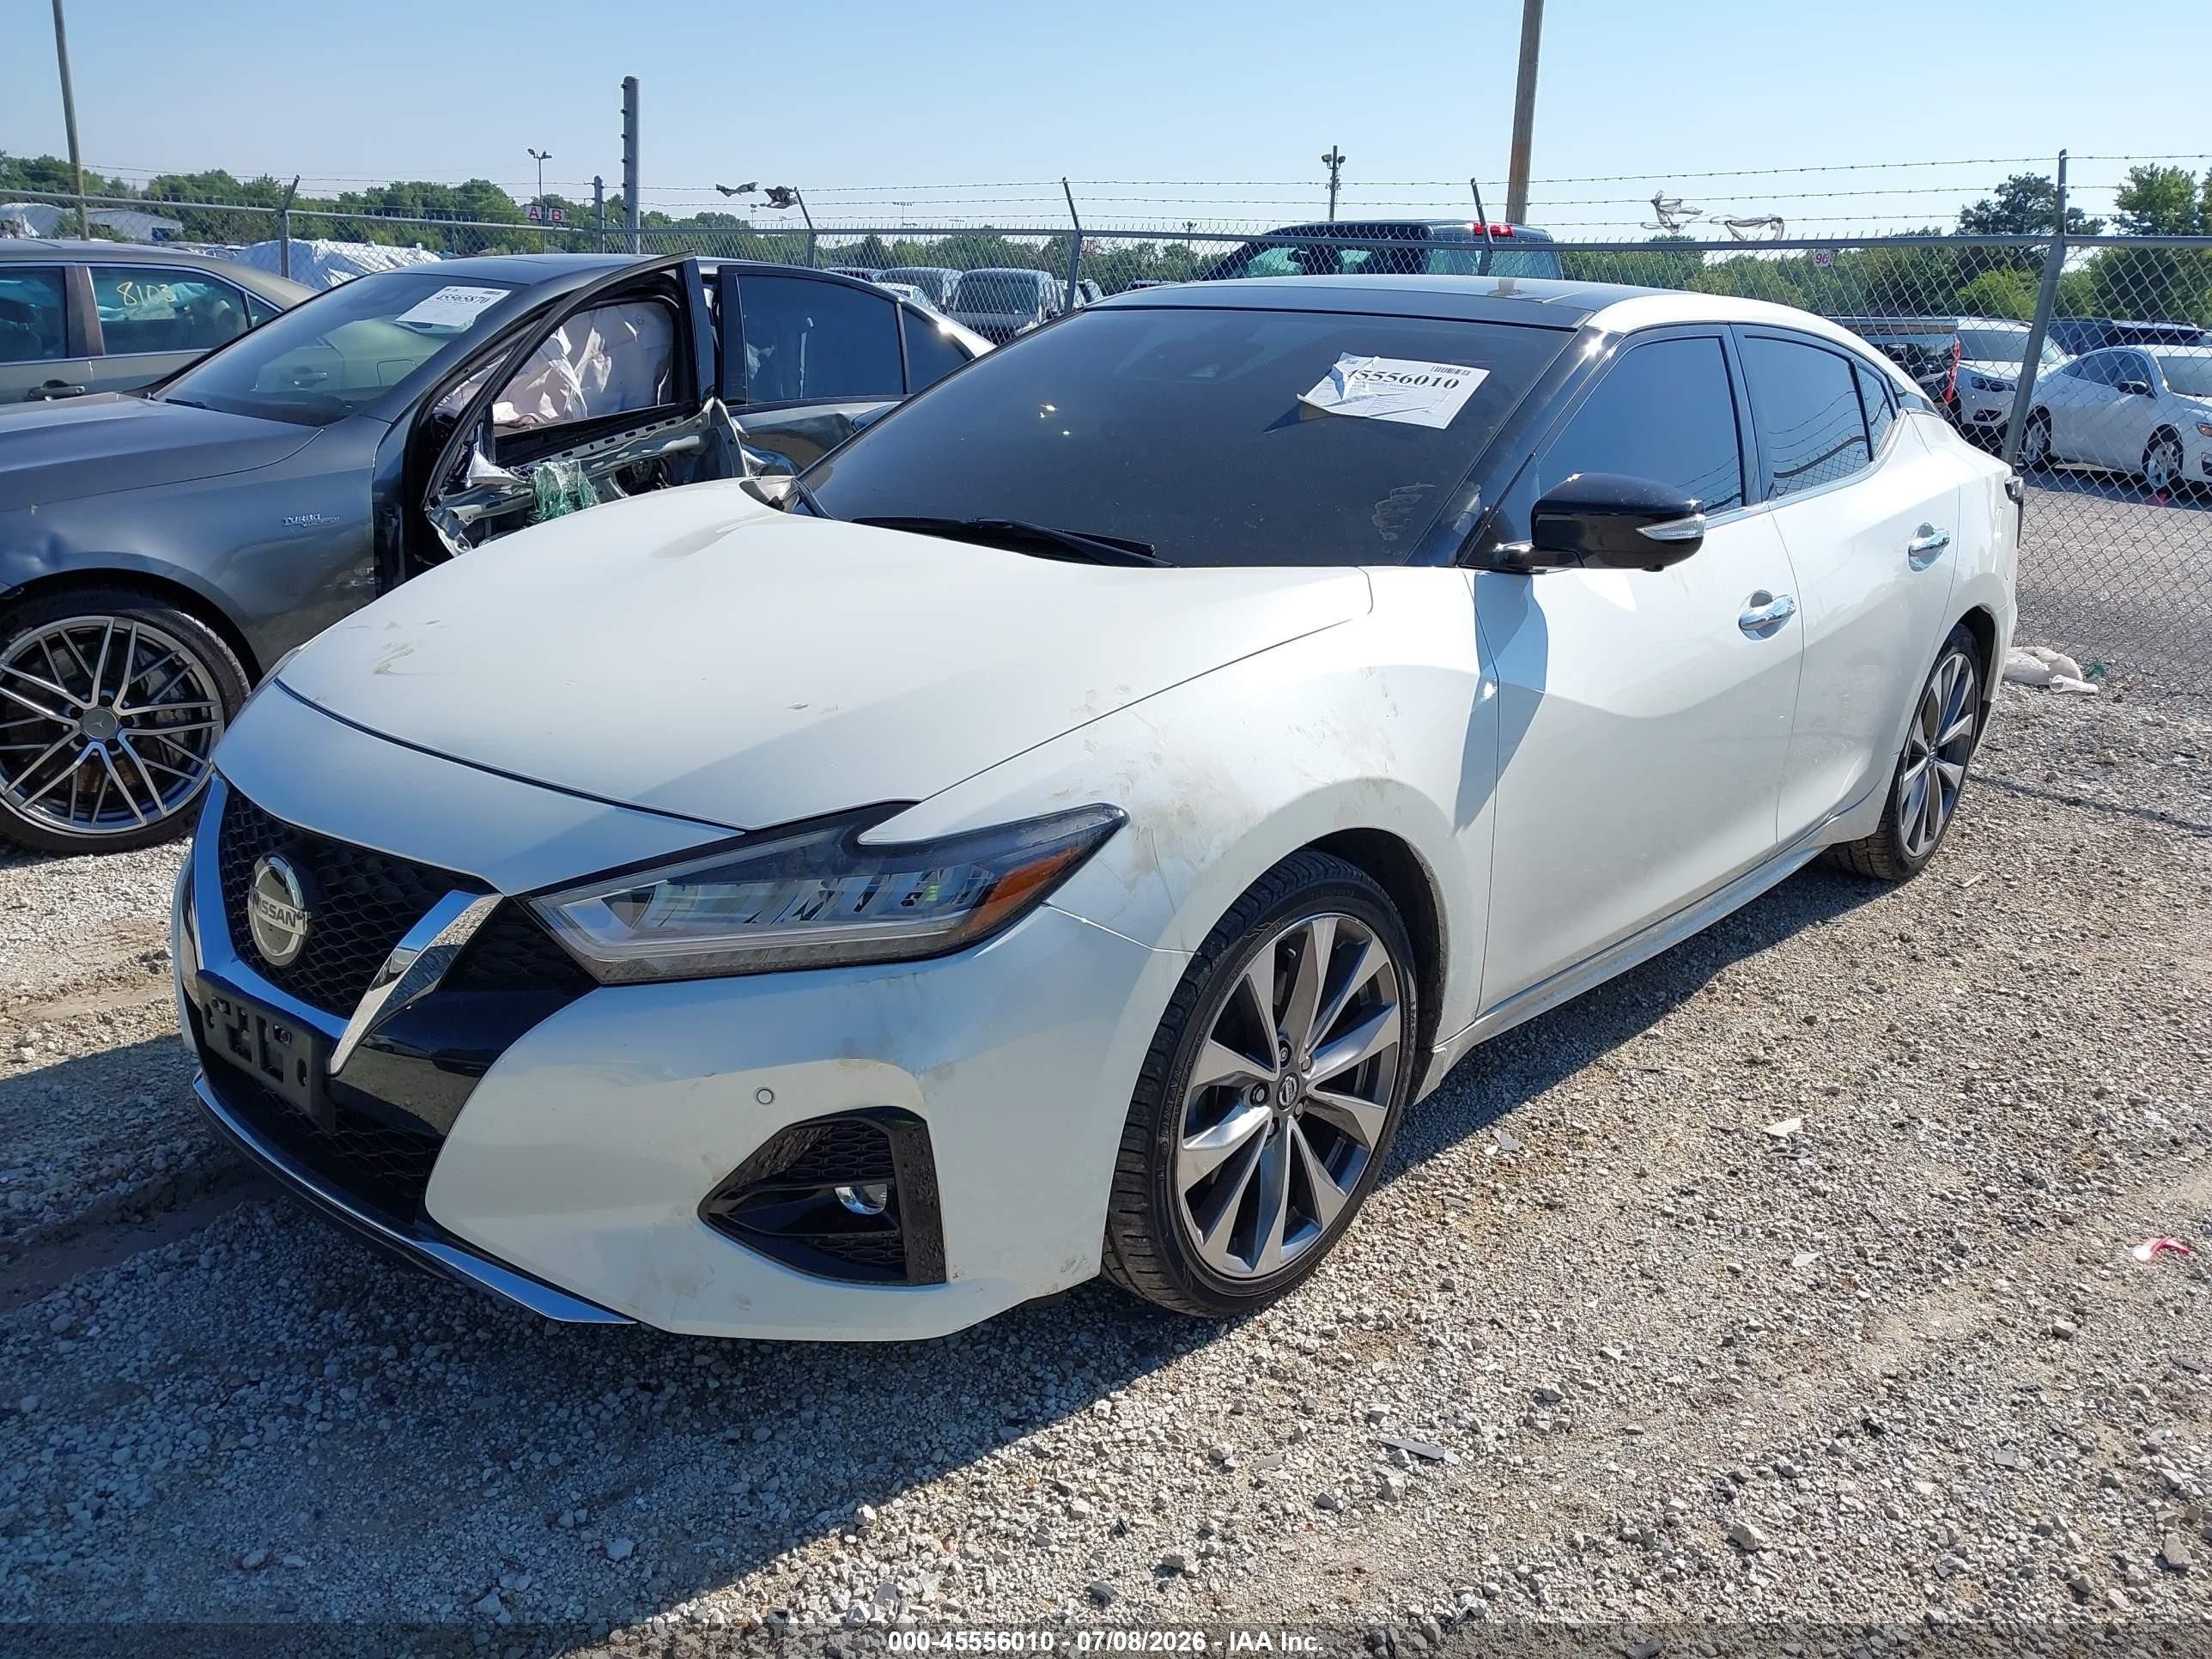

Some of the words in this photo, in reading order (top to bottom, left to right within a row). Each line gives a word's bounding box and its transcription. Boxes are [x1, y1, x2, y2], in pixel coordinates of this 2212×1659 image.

[529, 207, 539, 218] A
[552, 210, 562, 221] B
[117, 282, 179, 307] 8103
